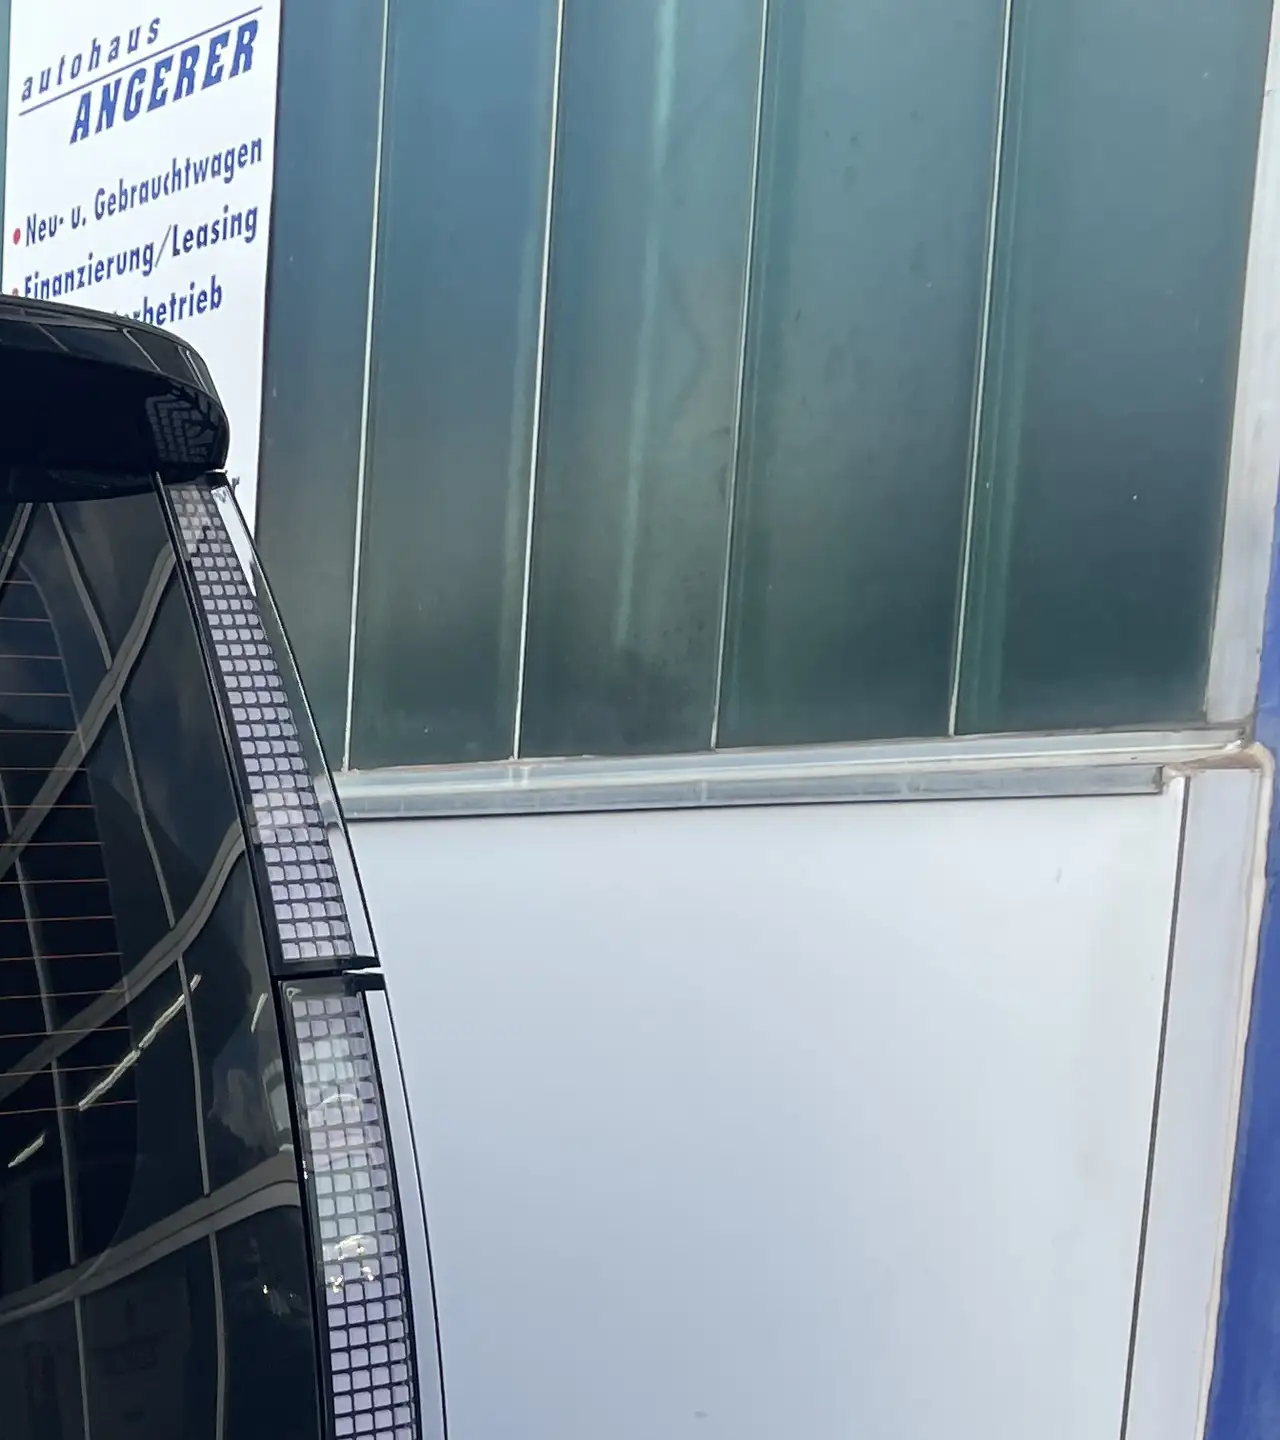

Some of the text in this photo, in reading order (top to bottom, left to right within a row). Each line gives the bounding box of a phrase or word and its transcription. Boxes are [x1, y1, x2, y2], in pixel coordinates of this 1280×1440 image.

[21, 17, 161, 102] autohaus
[69, 19, 259, 144] ANGERER
[25, 137, 262, 247] Neu- u. Gebrauchtwagen
